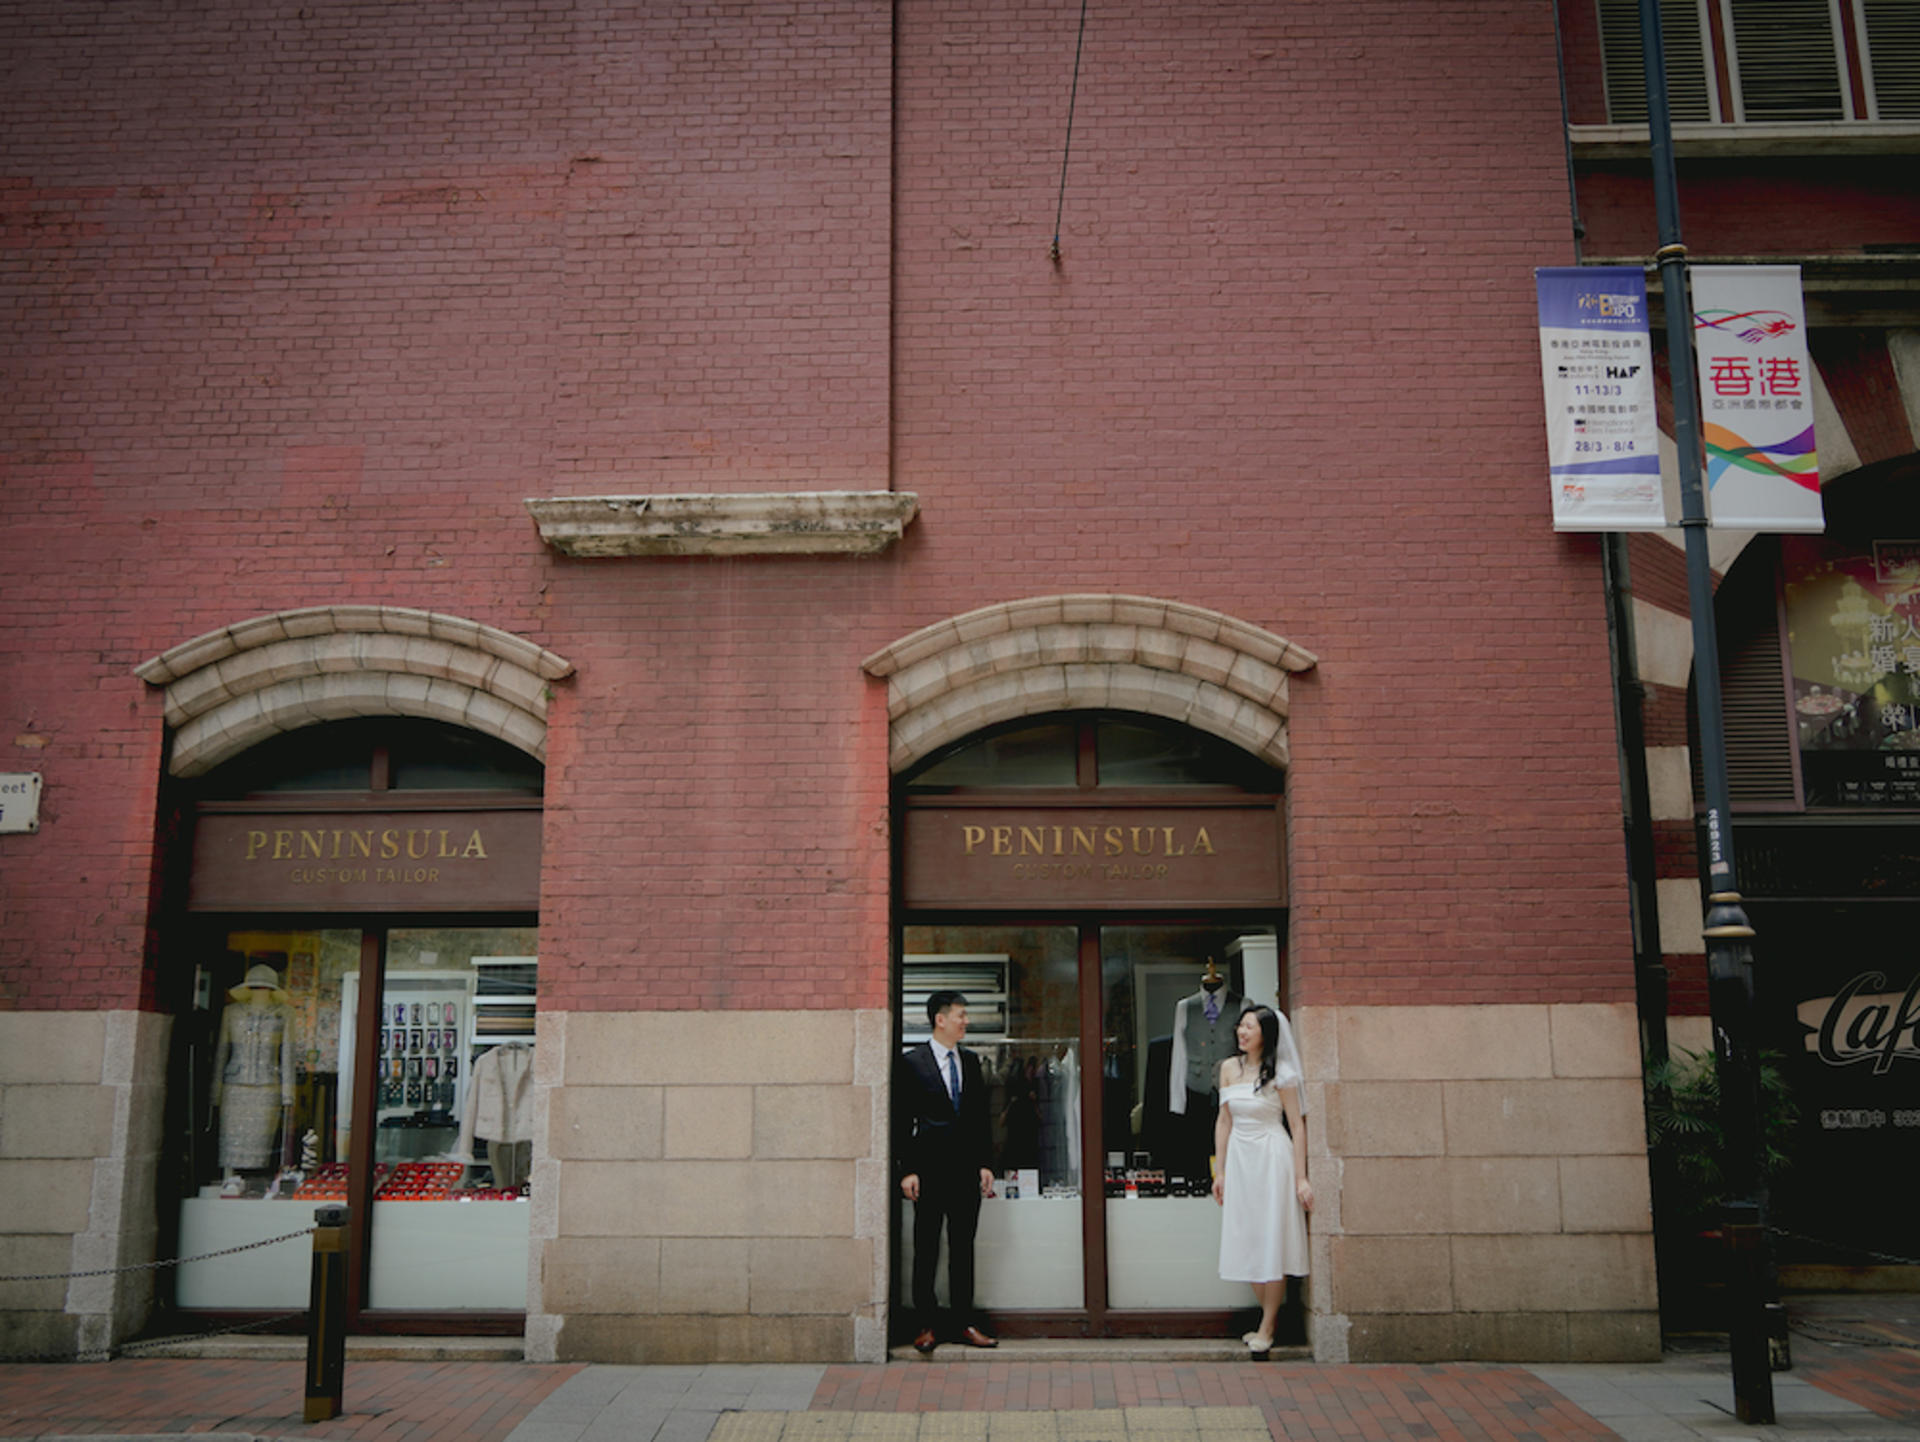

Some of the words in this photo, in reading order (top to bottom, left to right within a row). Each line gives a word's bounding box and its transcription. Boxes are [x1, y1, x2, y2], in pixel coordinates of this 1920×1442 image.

[1606, 366, 1640, 379] HAF
[1709, 356, 1803, 397] 香港
[1575, 385, 1622, 396] 11-13/3
[1711, 399, 1804, 411] 亞洲國際都會
[1575, 440, 1603, 452] 28/3
[1613, 440, 1635, 452] 8/4
[245, 828, 489, 860] PENINSULA
[962, 825, 1217, 857] PENINSULA
[290, 868, 367, 884] CUSTOM
[376, 867, 441, 883] TAILOR
[1012, 863, 1092, 881] CUSTOM
[1101, 863, 1169, 881] TAILOR
[1817, 970, 1920, 1075] Caf
